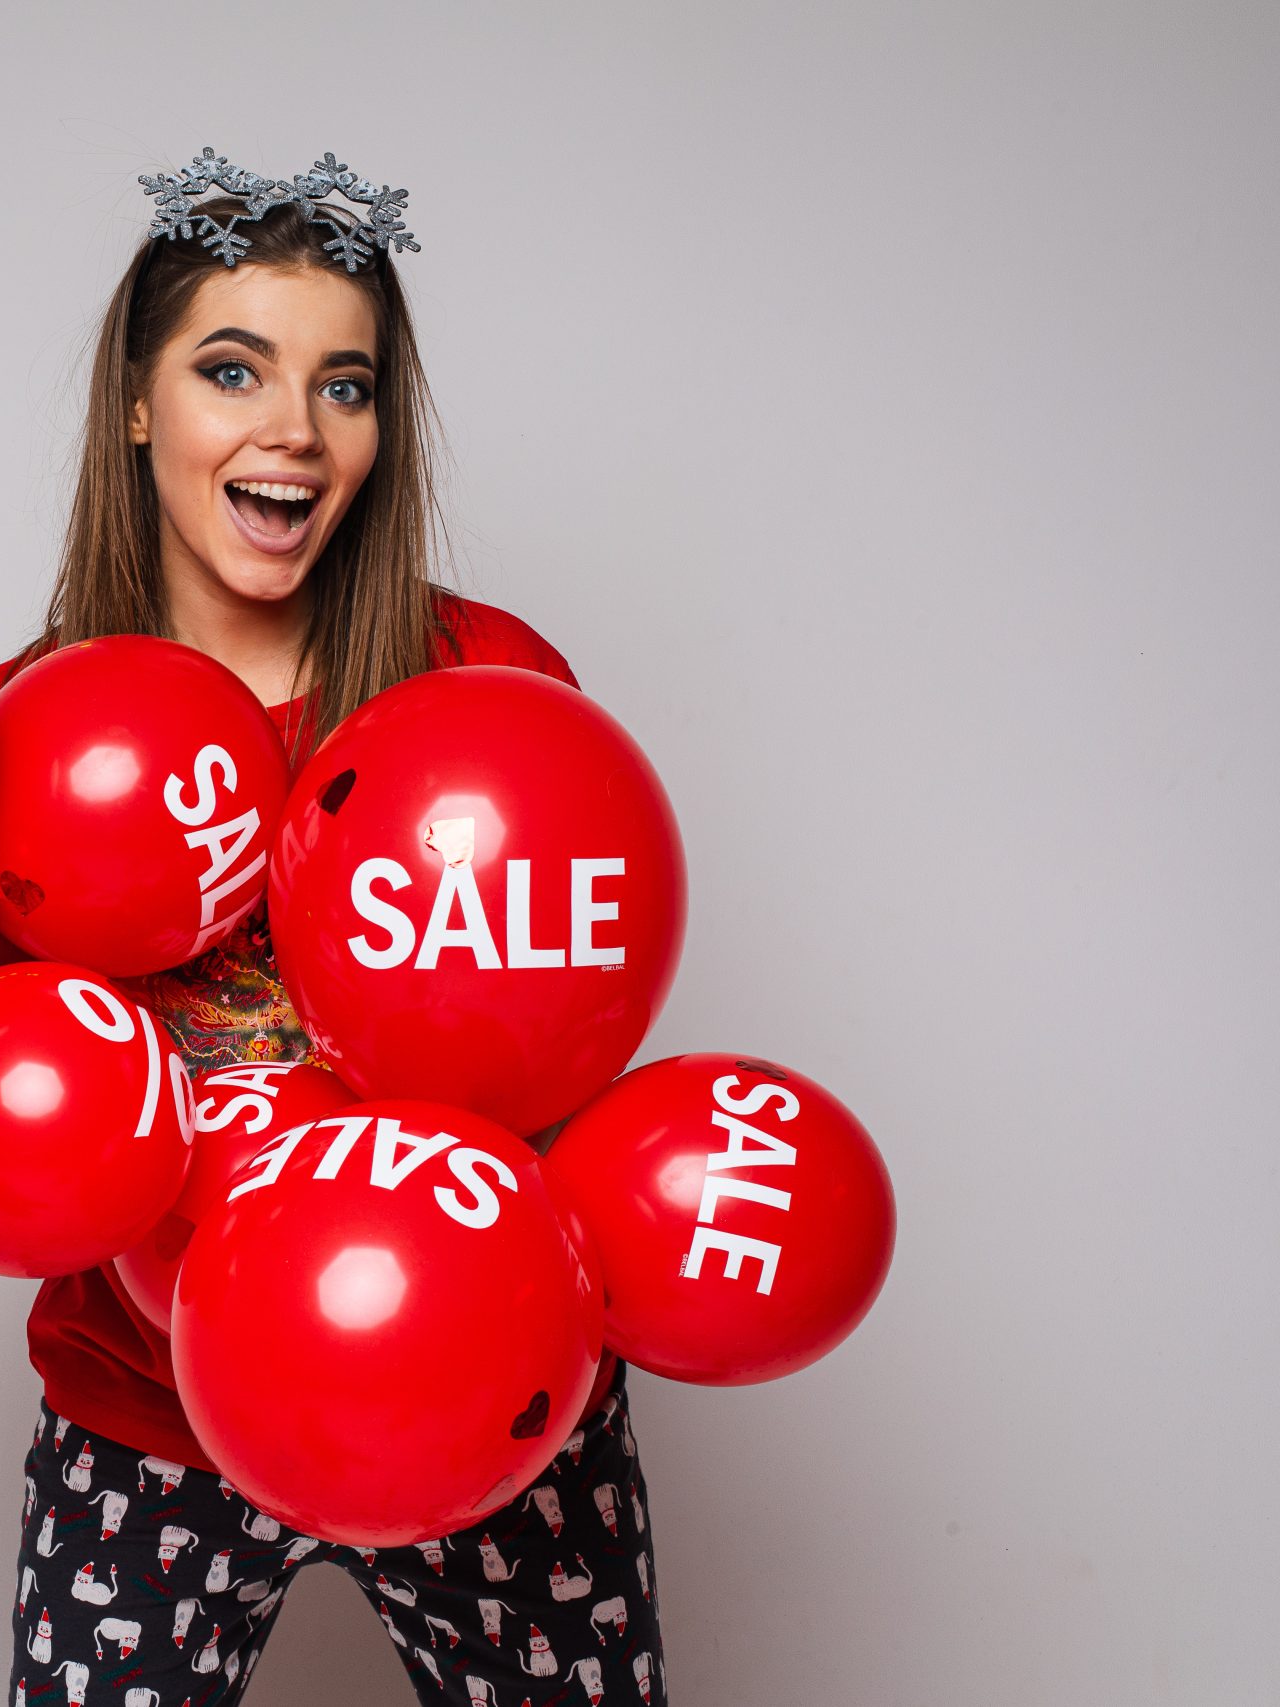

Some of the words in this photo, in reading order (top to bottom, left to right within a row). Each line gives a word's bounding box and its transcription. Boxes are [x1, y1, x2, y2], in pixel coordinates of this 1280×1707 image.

[347, 858, 626, 970] SALE
[226, 1117, 518, 1230] SALE
[684, 1075, 800, 1296] SALE
